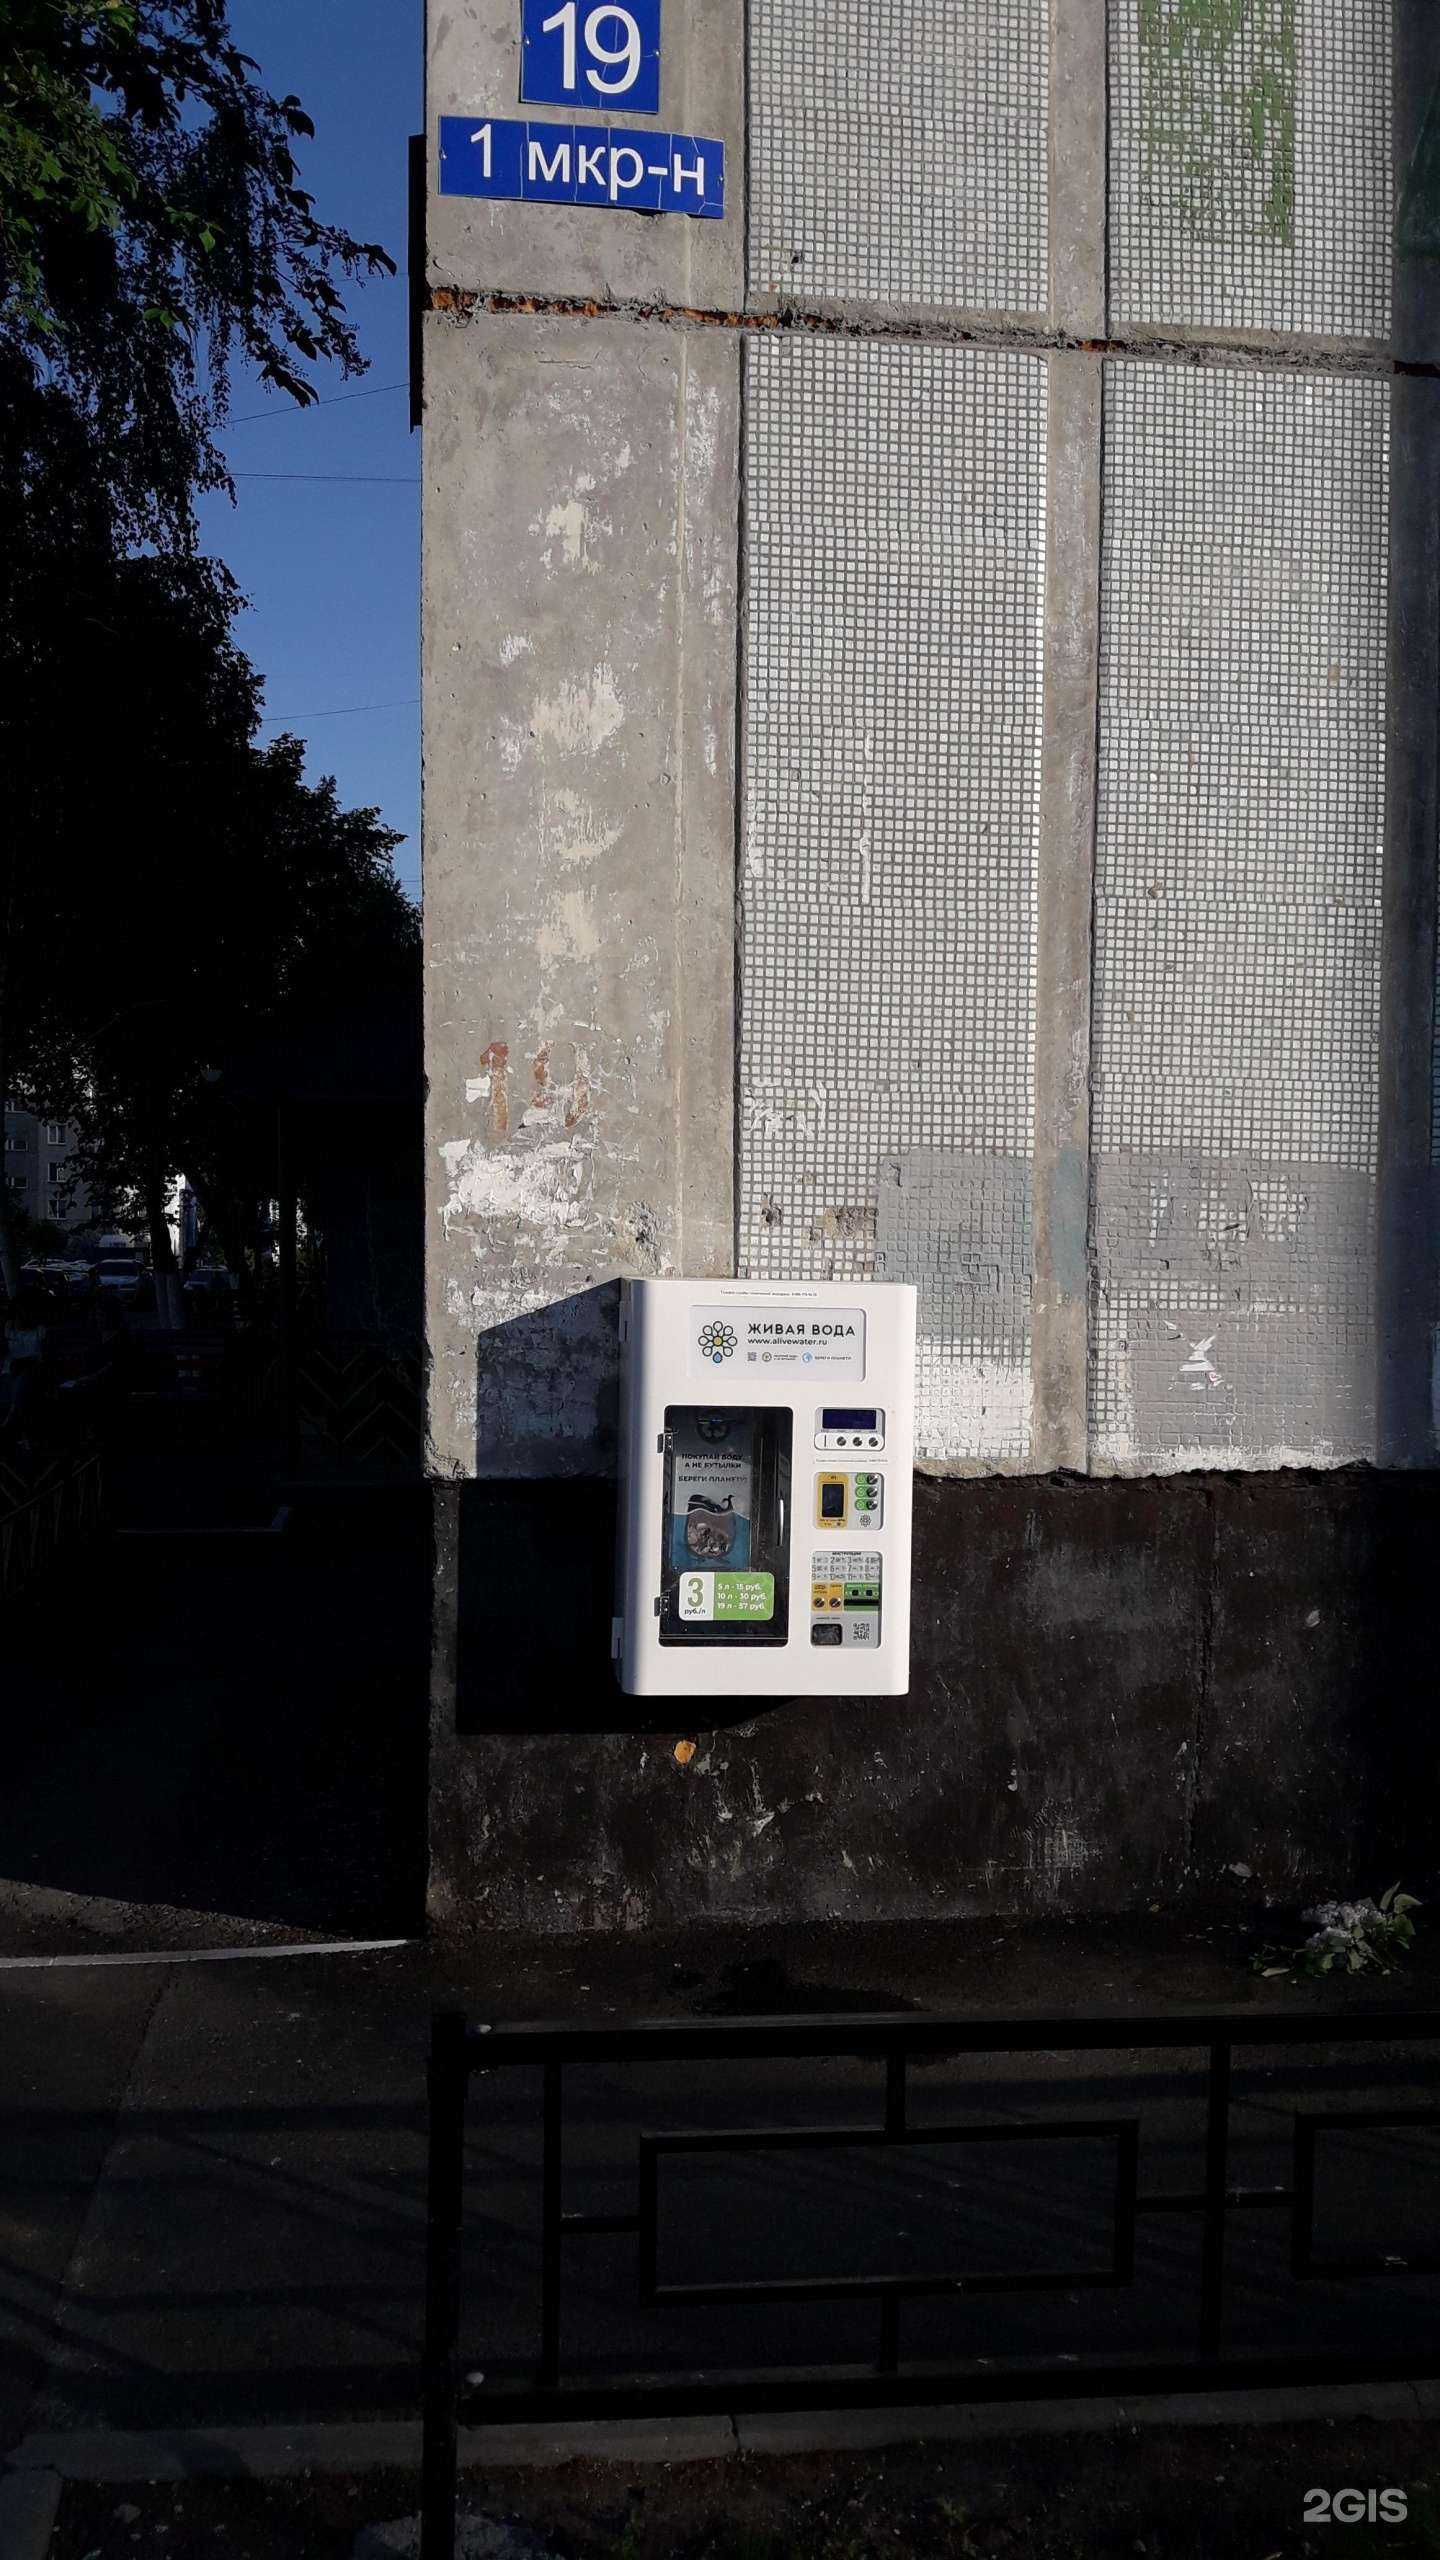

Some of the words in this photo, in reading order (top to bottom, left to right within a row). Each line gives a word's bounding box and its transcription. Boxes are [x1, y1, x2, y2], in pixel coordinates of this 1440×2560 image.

[542, 2, 641, 94] 19
[470, 123, 491, 178] 1
[528, 141, 705, 200] мкр-н
[748, 1323, 805, 1335] ЖИВАЯ
[812, 1324, 855, 1337] ВОДА
[748, 1338, 828, 1346] www.alivewater.ru
[687, 1577, 704, 1607] 3
